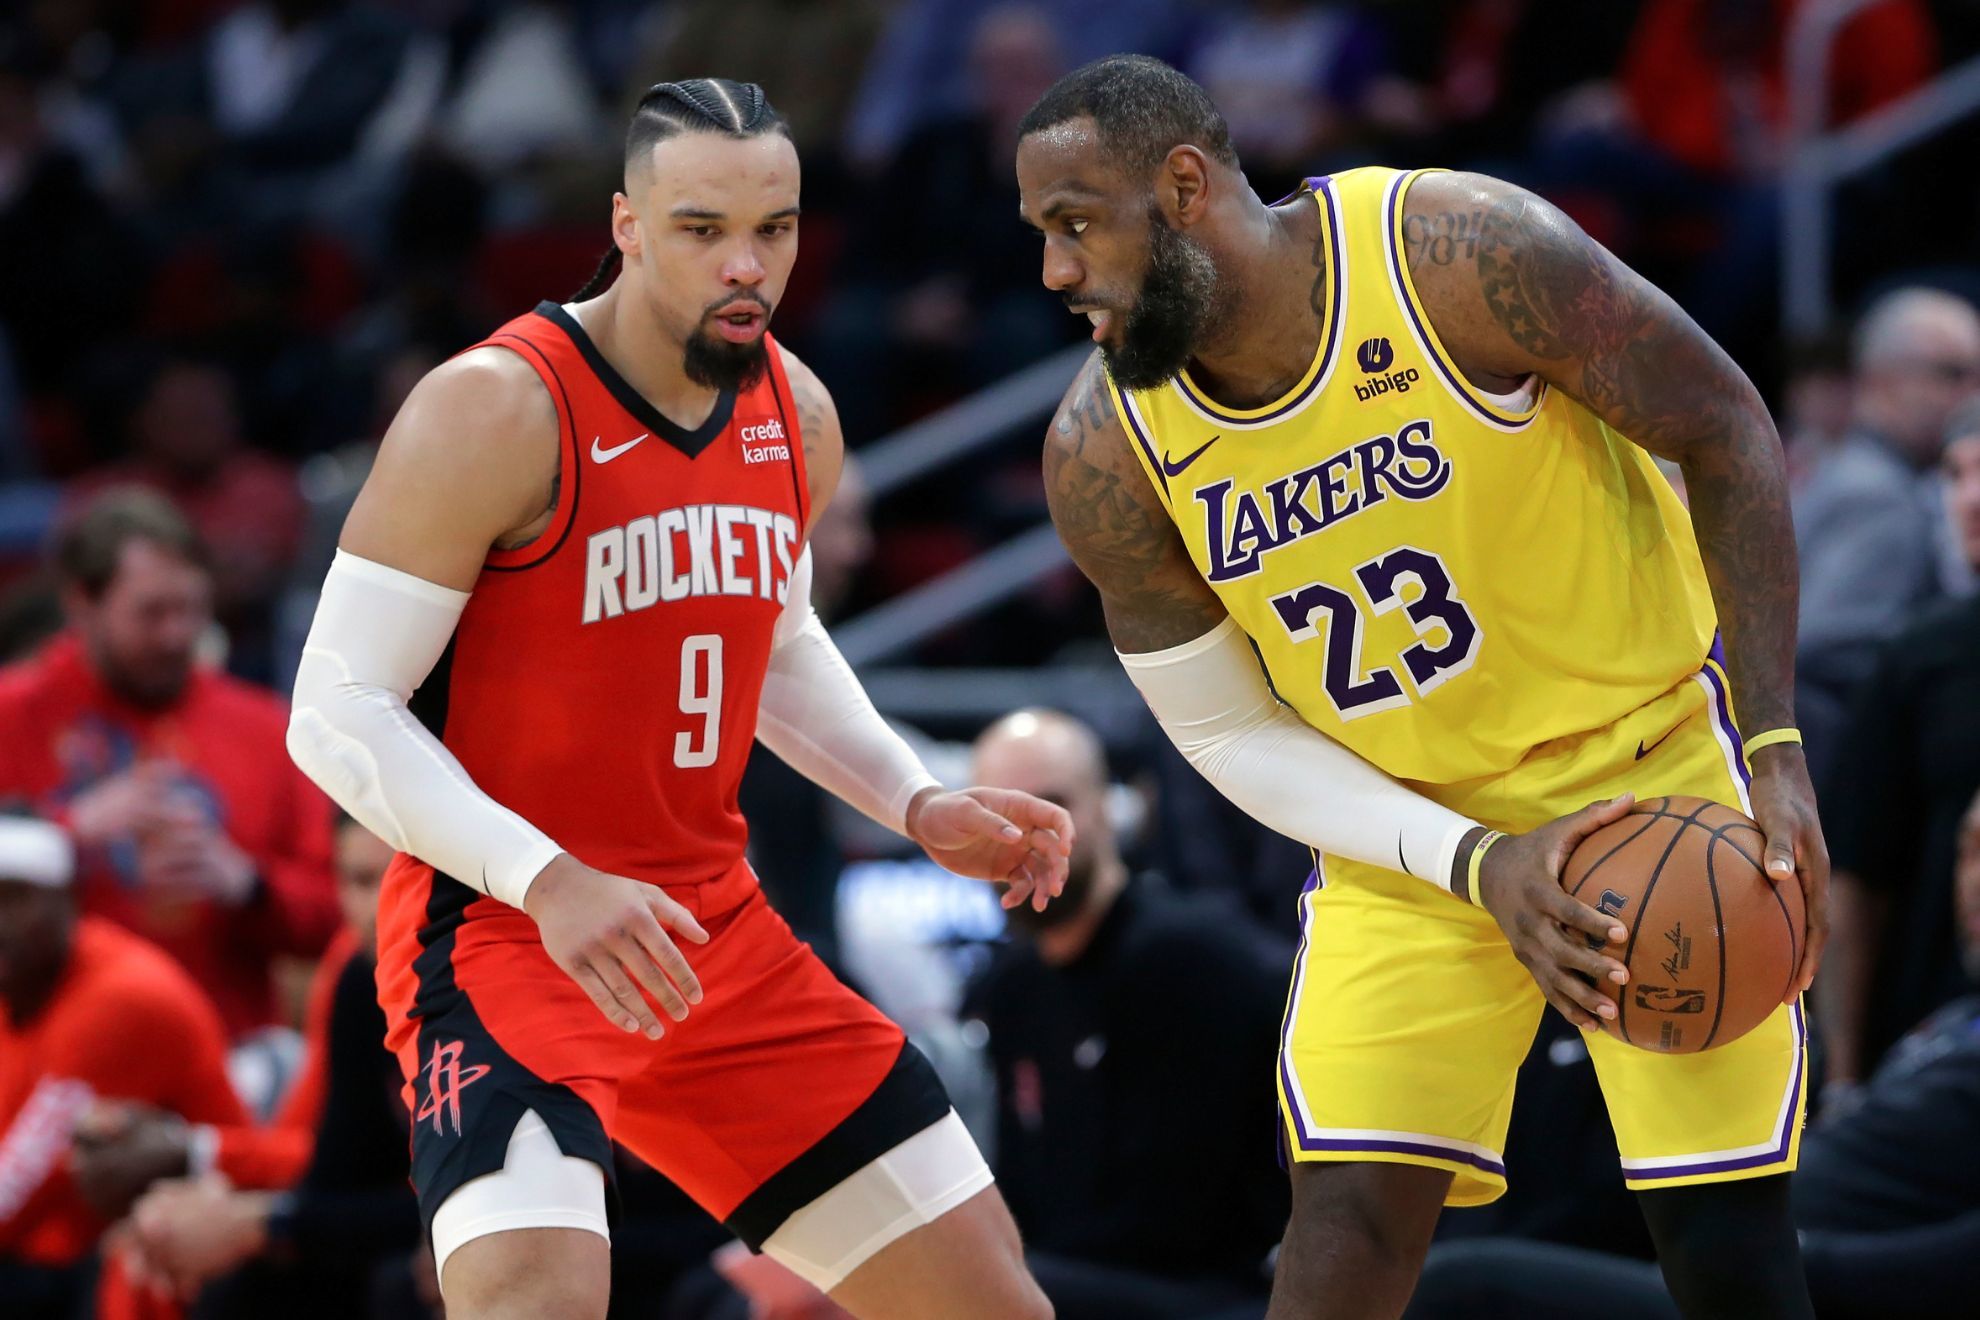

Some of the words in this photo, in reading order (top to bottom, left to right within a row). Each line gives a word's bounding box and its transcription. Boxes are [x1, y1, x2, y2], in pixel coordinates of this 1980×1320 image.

[741, 419, 785, 442] credit
[1353, 368, 1420, 402] bibigo
[742, 444, 790, 465] karma
[1192, 418, 1453, 584] LAKERS
[582, 503, 797, 626] ROCKETS
[1266, 545, 1484, 723] 23
[673, 633, 723, 769] 9
